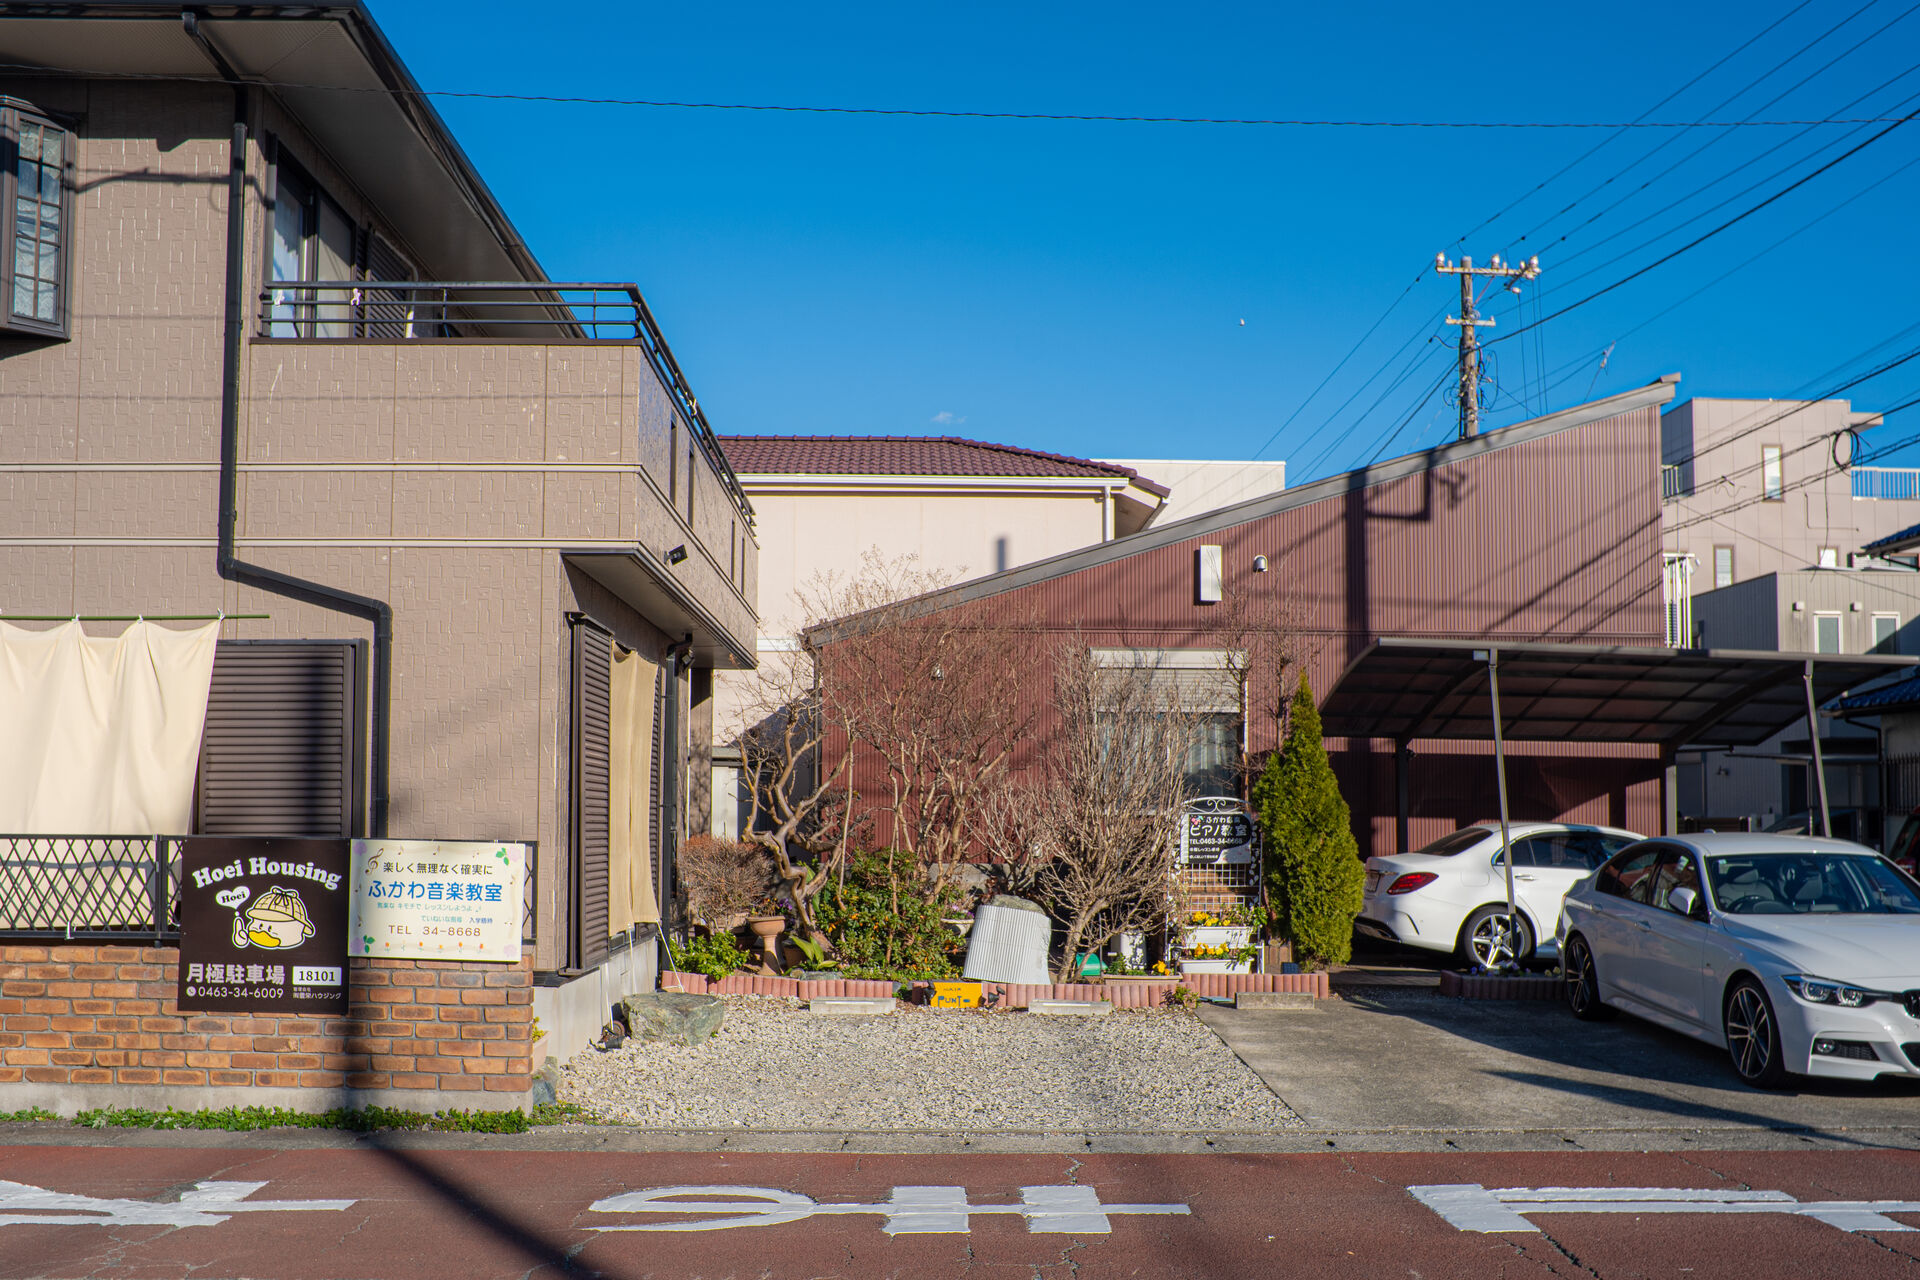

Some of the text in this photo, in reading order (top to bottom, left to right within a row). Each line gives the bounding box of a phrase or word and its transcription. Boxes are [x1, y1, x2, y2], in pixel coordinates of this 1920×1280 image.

[1190, 824, 1247, 837] ピアノ教室
[192, 857, 342, 891] Hoei Housing
[383, 862, 493, 875] 楽しく無理なく確実に
[221, 891, 247, 904] Hoei
[368, 880, 503, 902] ふかわ音楽教室
[388, 925, 481, 937] TEL 34-8668
[186, 963, 286, 985] 月極駐車場
[298, 970, 336, 982] 18101
[198, 986, 284, 999] 0463-34-6009
